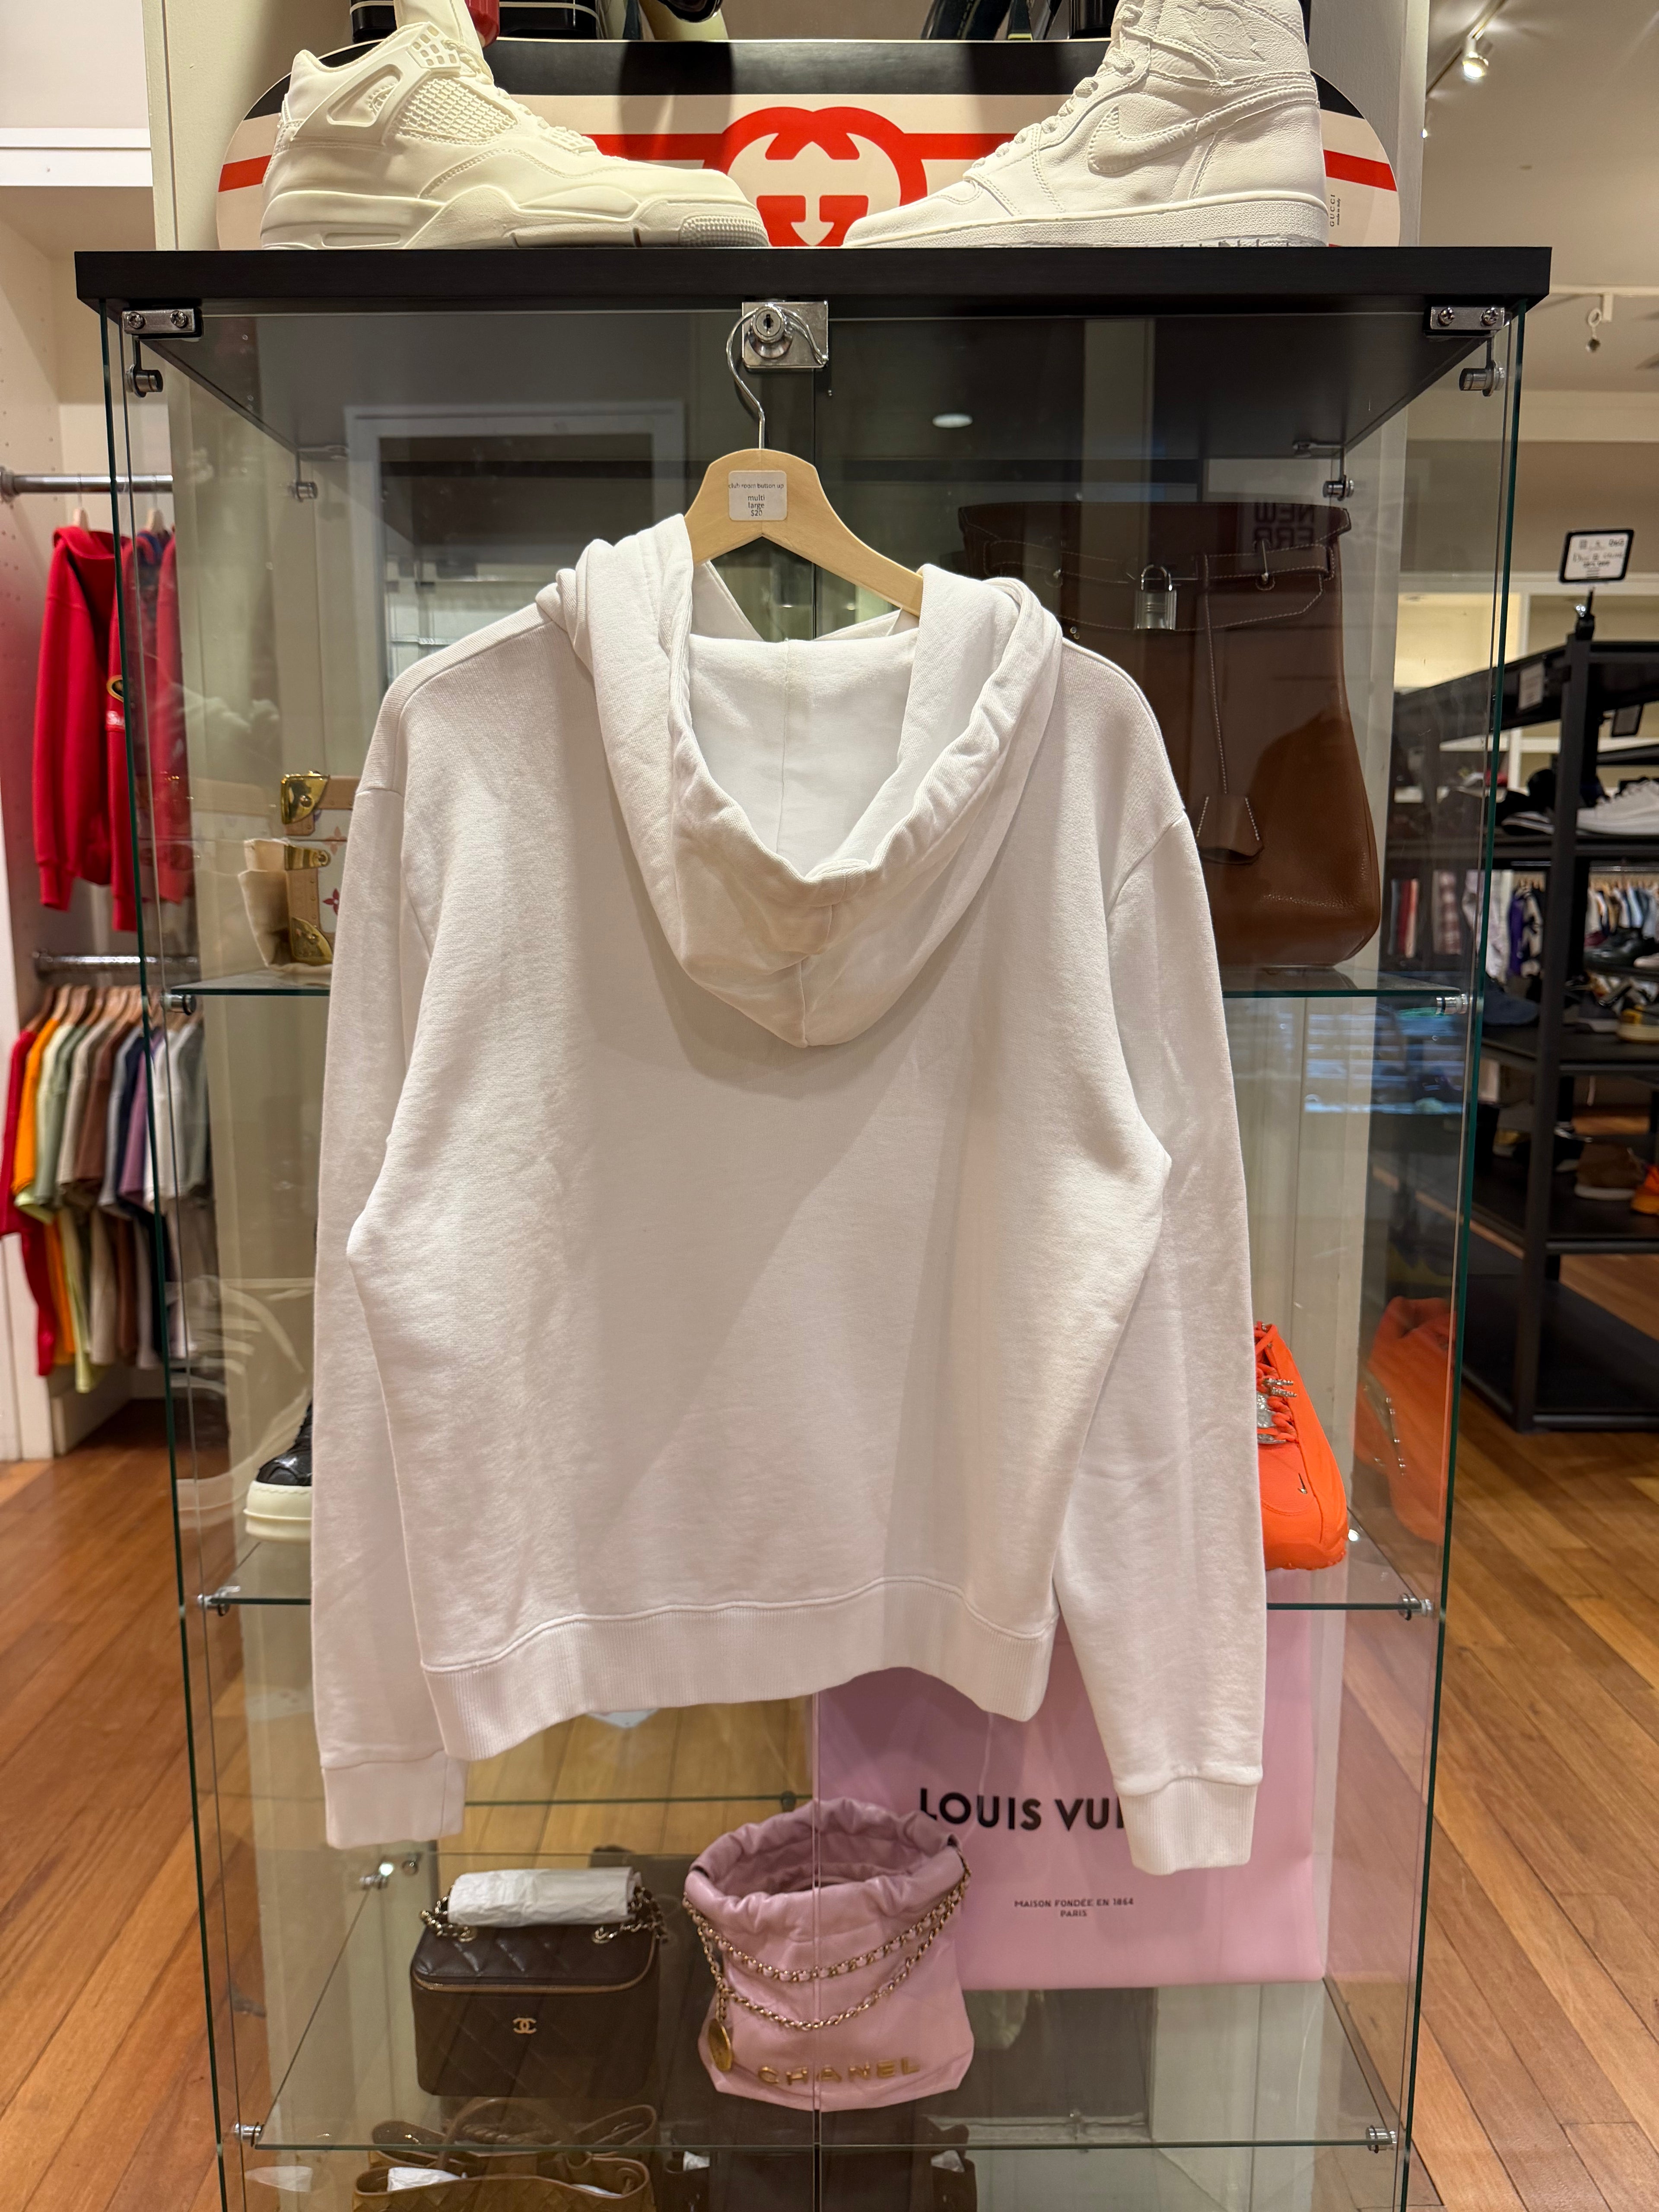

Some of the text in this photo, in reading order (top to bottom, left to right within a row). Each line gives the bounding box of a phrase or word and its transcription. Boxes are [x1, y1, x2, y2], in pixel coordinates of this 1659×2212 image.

[920, 1788, 1041, 1830] LOUIS
[1096, 1898, 1109, 1907] EN
[759, 2058, 919, 2085] CHANEL
